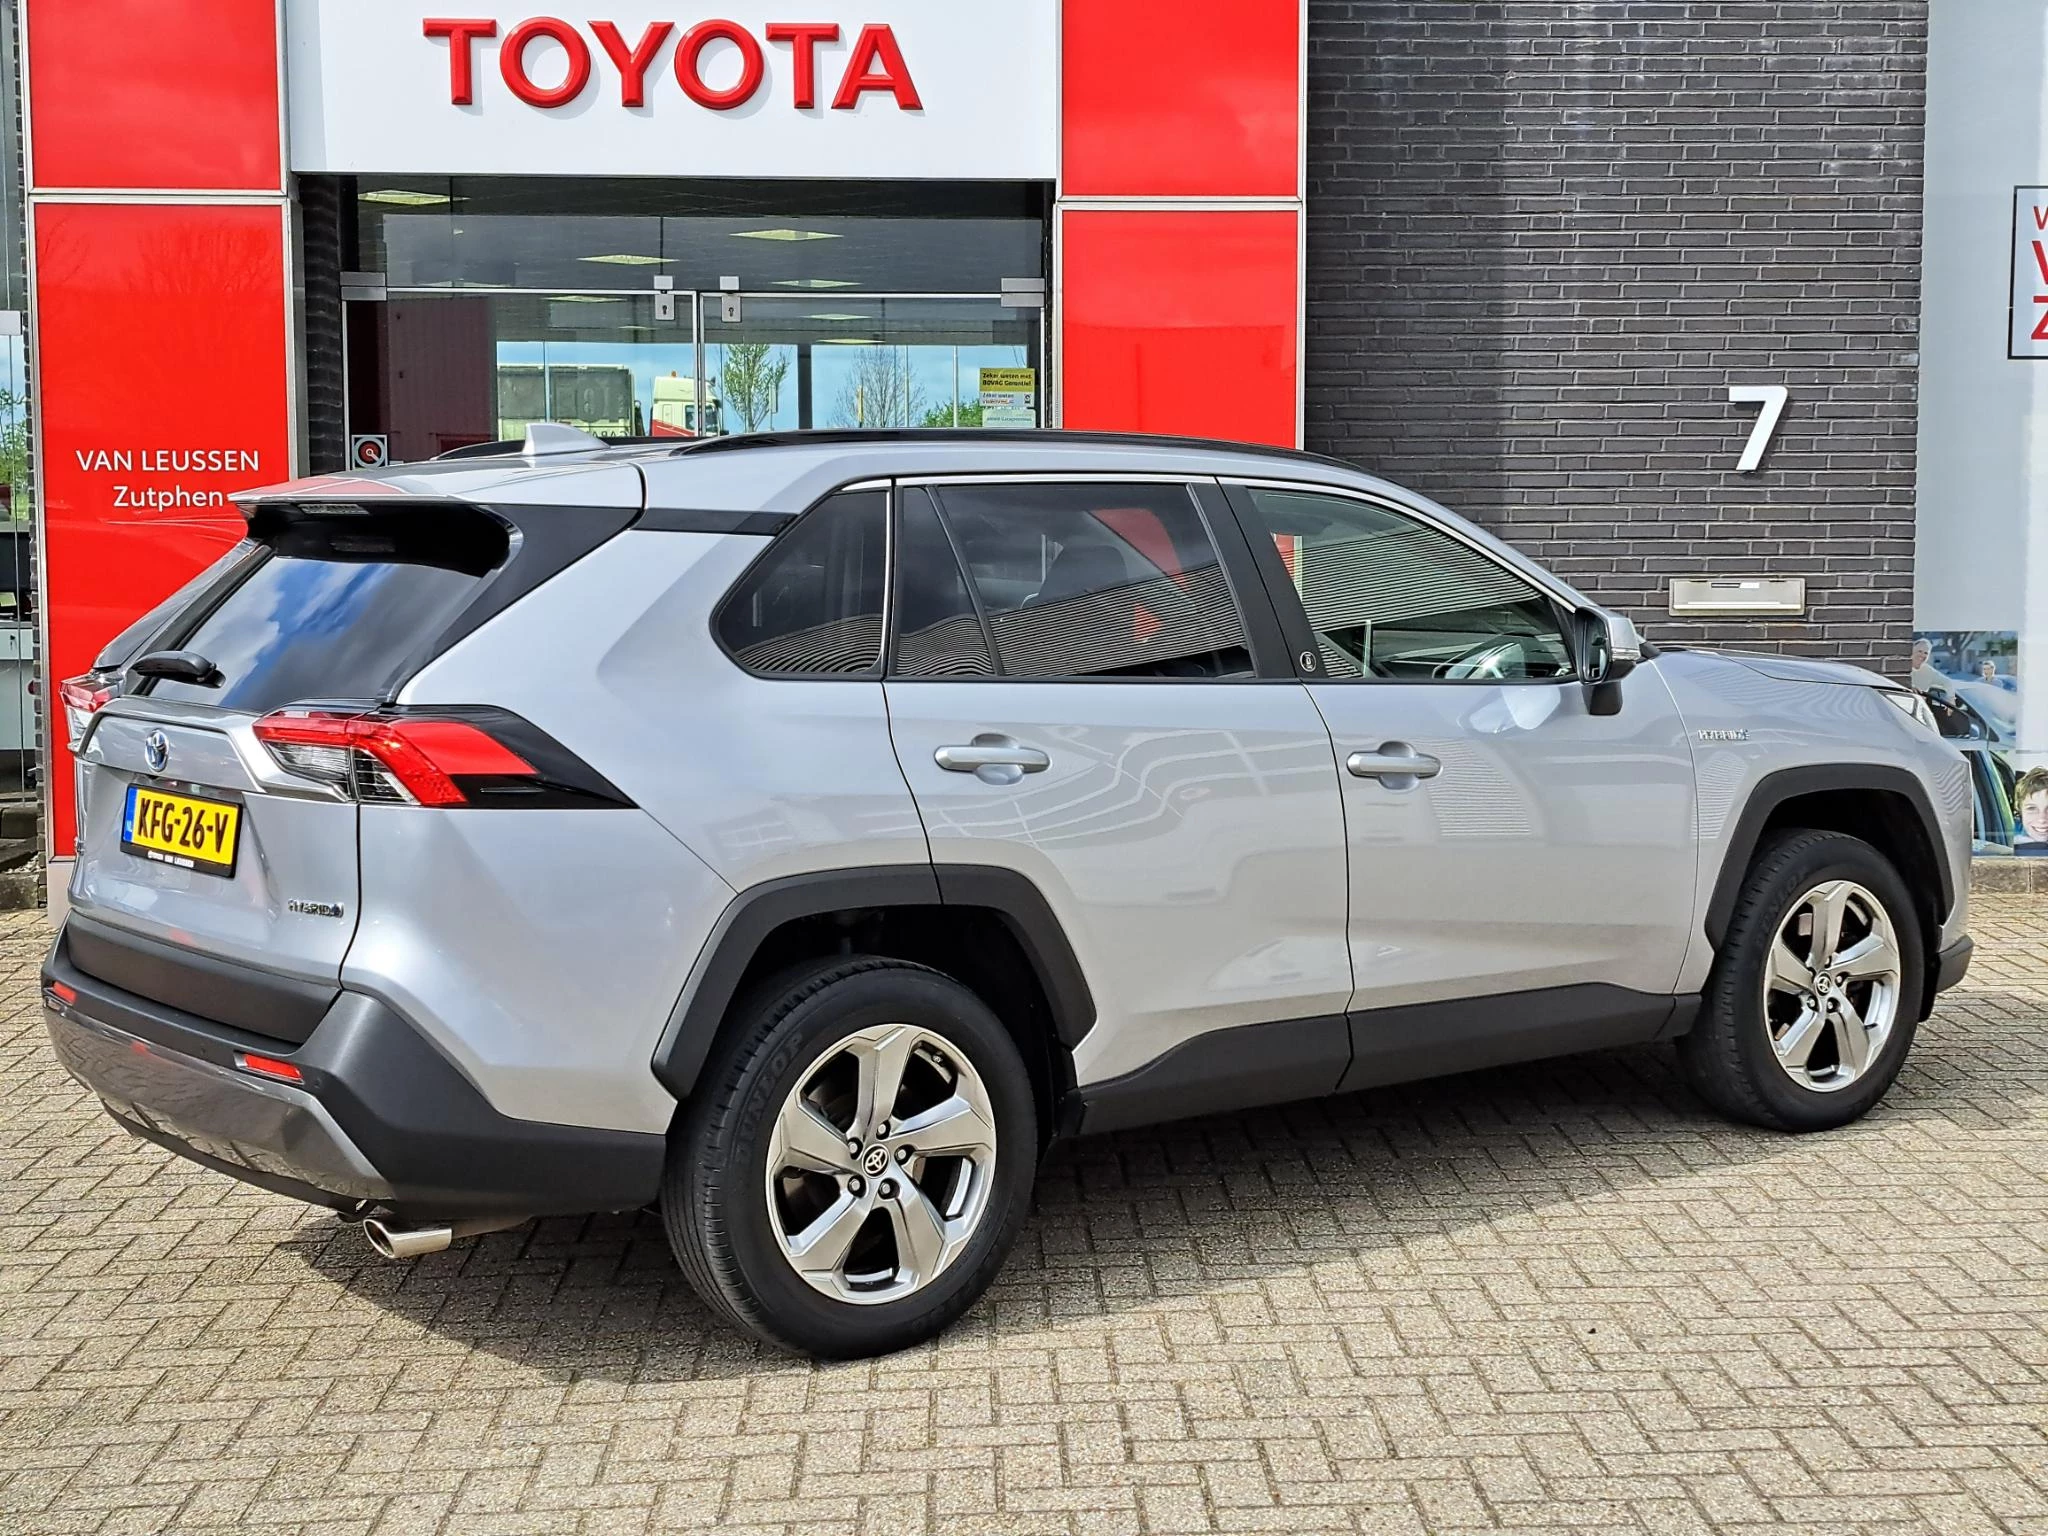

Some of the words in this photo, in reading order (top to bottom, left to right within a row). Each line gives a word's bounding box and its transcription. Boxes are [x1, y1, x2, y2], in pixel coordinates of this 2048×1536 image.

[422, 16, 924, 110] TOYOTA
[1729, 386, 1788, 471] 7
[76, 450, 132, 471] VAN
[142, 450, 259, 471] LEUSSEN
[113, 485, 223, 511] Zutphen
[138, 798, 229, 853] KFG-26-V
